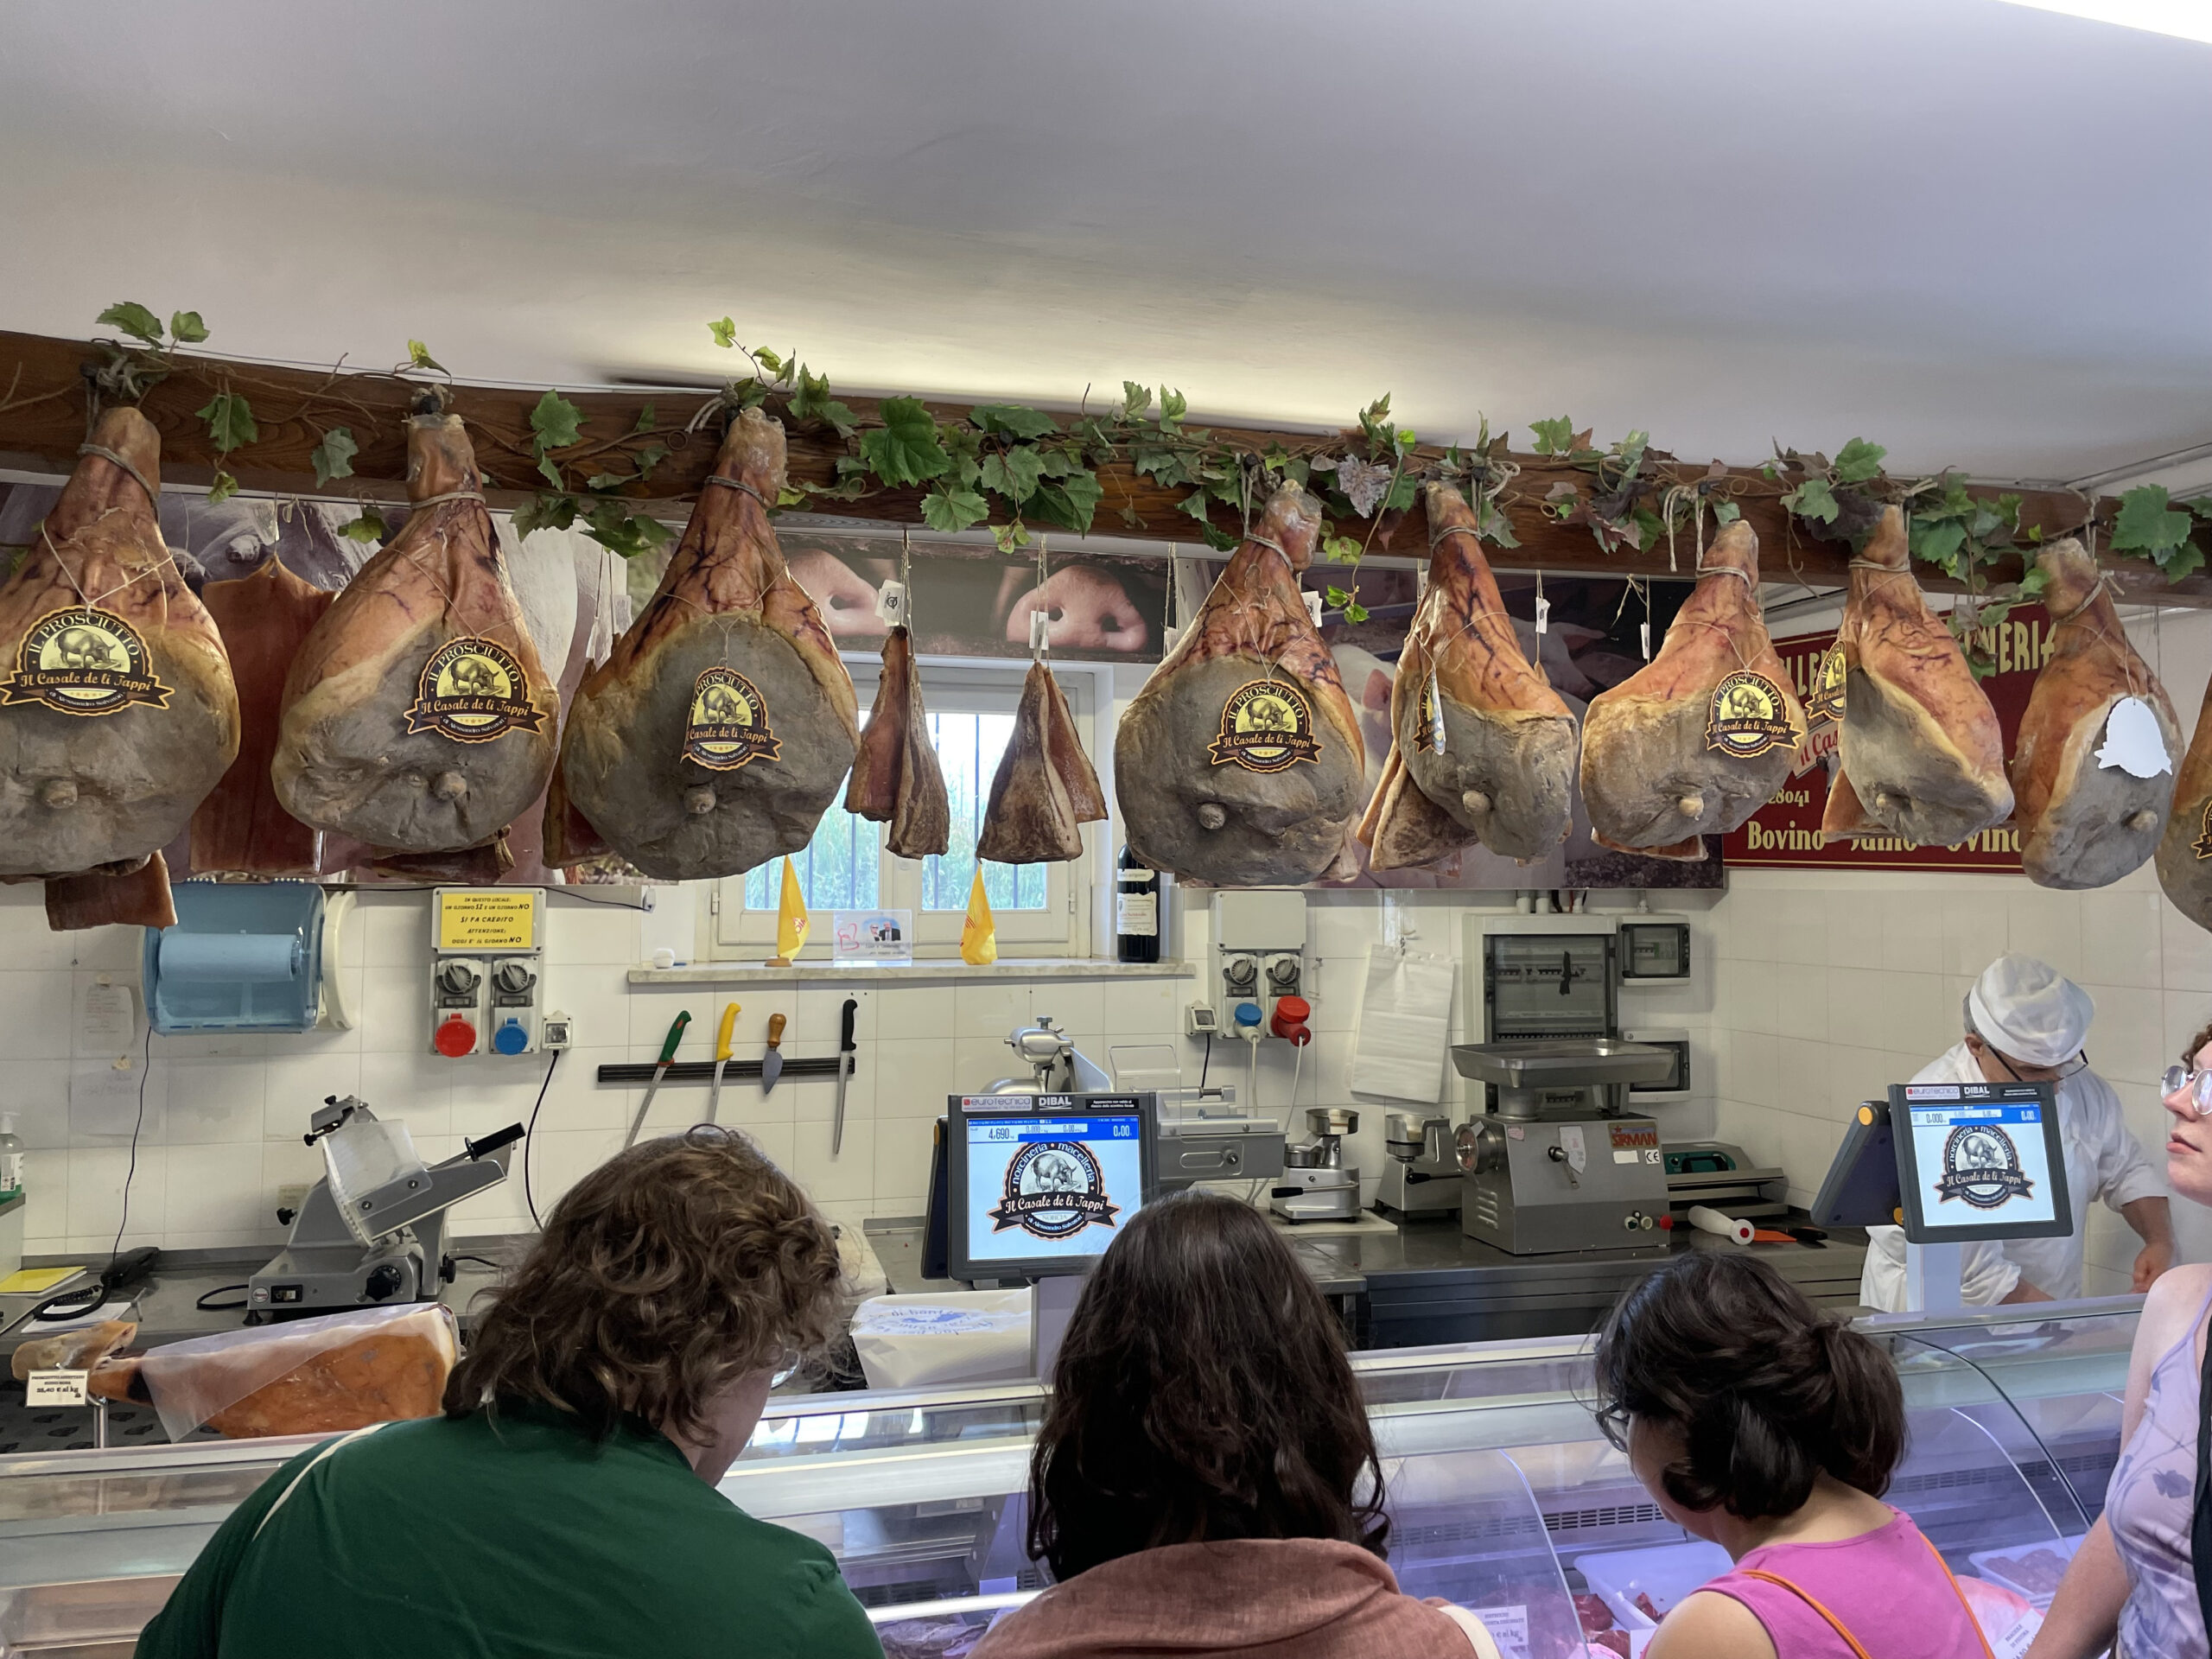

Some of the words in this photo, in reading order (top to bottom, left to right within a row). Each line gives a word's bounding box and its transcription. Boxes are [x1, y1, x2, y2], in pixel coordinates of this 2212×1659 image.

[29, 639, 45, 654] IL
[40, 614, 141, 656] PROSCIUTTO
[429, 667, 442, 682] IL
[438, 645, 519, 682] PROSCIUTTO
[37, 672, 81, 684] Casale
[84, 672, 99, 683] de
[101, 674, 111, 685] li
[114, 676, 152, 691] Tappi
[696, 674, 759, 710] PROSCIUTTO
[1720, 677, 1779, 706] PROSCIUTTO
[421, 702, 431, 715] Il
[434, 698, 469, 712] Casale
[472, 698, 484, 710] de
[486, 699, 494, 710] li
[497, 702, 530, 716] Tappi
[1229, 708, 1239, 720] IL
[1236, 686, 1304, 718] PROSCIUTTO
[690, 727, 716, 739] Casale
[719, 727, 729, 737] de
[731, 728, 738, 737] li
[741, 728, 767, 743] Tappi
[1718, 721, 1741, 732] Casale
[1744, 721, 1751, 730] de
[1753, 721, 1759, 730] li
[1762, 722, 1788, 734] Tappi
[1224, 736, 1232, 748] Il
[1234, 734, 1262, 746] Casale
[1264, 734, 1274, 743] de
[1276, 734, 1283, 744] li
[1285, 735, 1311, 748] Tappi
[1747, 820, 1825, 850] Bovino
[1039, 1096, 1072, 1106] DIBAL
[988, 1128, 1009, 1140] 4,690
[1113, 1125, 1129, 1137] 0,00
[1949, 1127, 1973, 1162] norcineria
[1980, 1126, 2012, 1160] macelleria
[1013, 1143, 1047, 1185] norcineria
[1058, 1142, 1096, 1182] macelleria
[1955, 1172, 1980, 1183] Casale
[1982, 1171, 1991, 1180] de
[1992, 1171, 1998, 1180] li
[1999, 1172, 2021, 1185] Tappi
[1006, 1201, 1016, 1213] Il
[1018, 1195, 1051, 1211] Casale
[1053, 1195, 1064, 1206] de
[1066, 1195, 1073, 1206] li
[1075, 1197, 1105, 1211] Tappi
